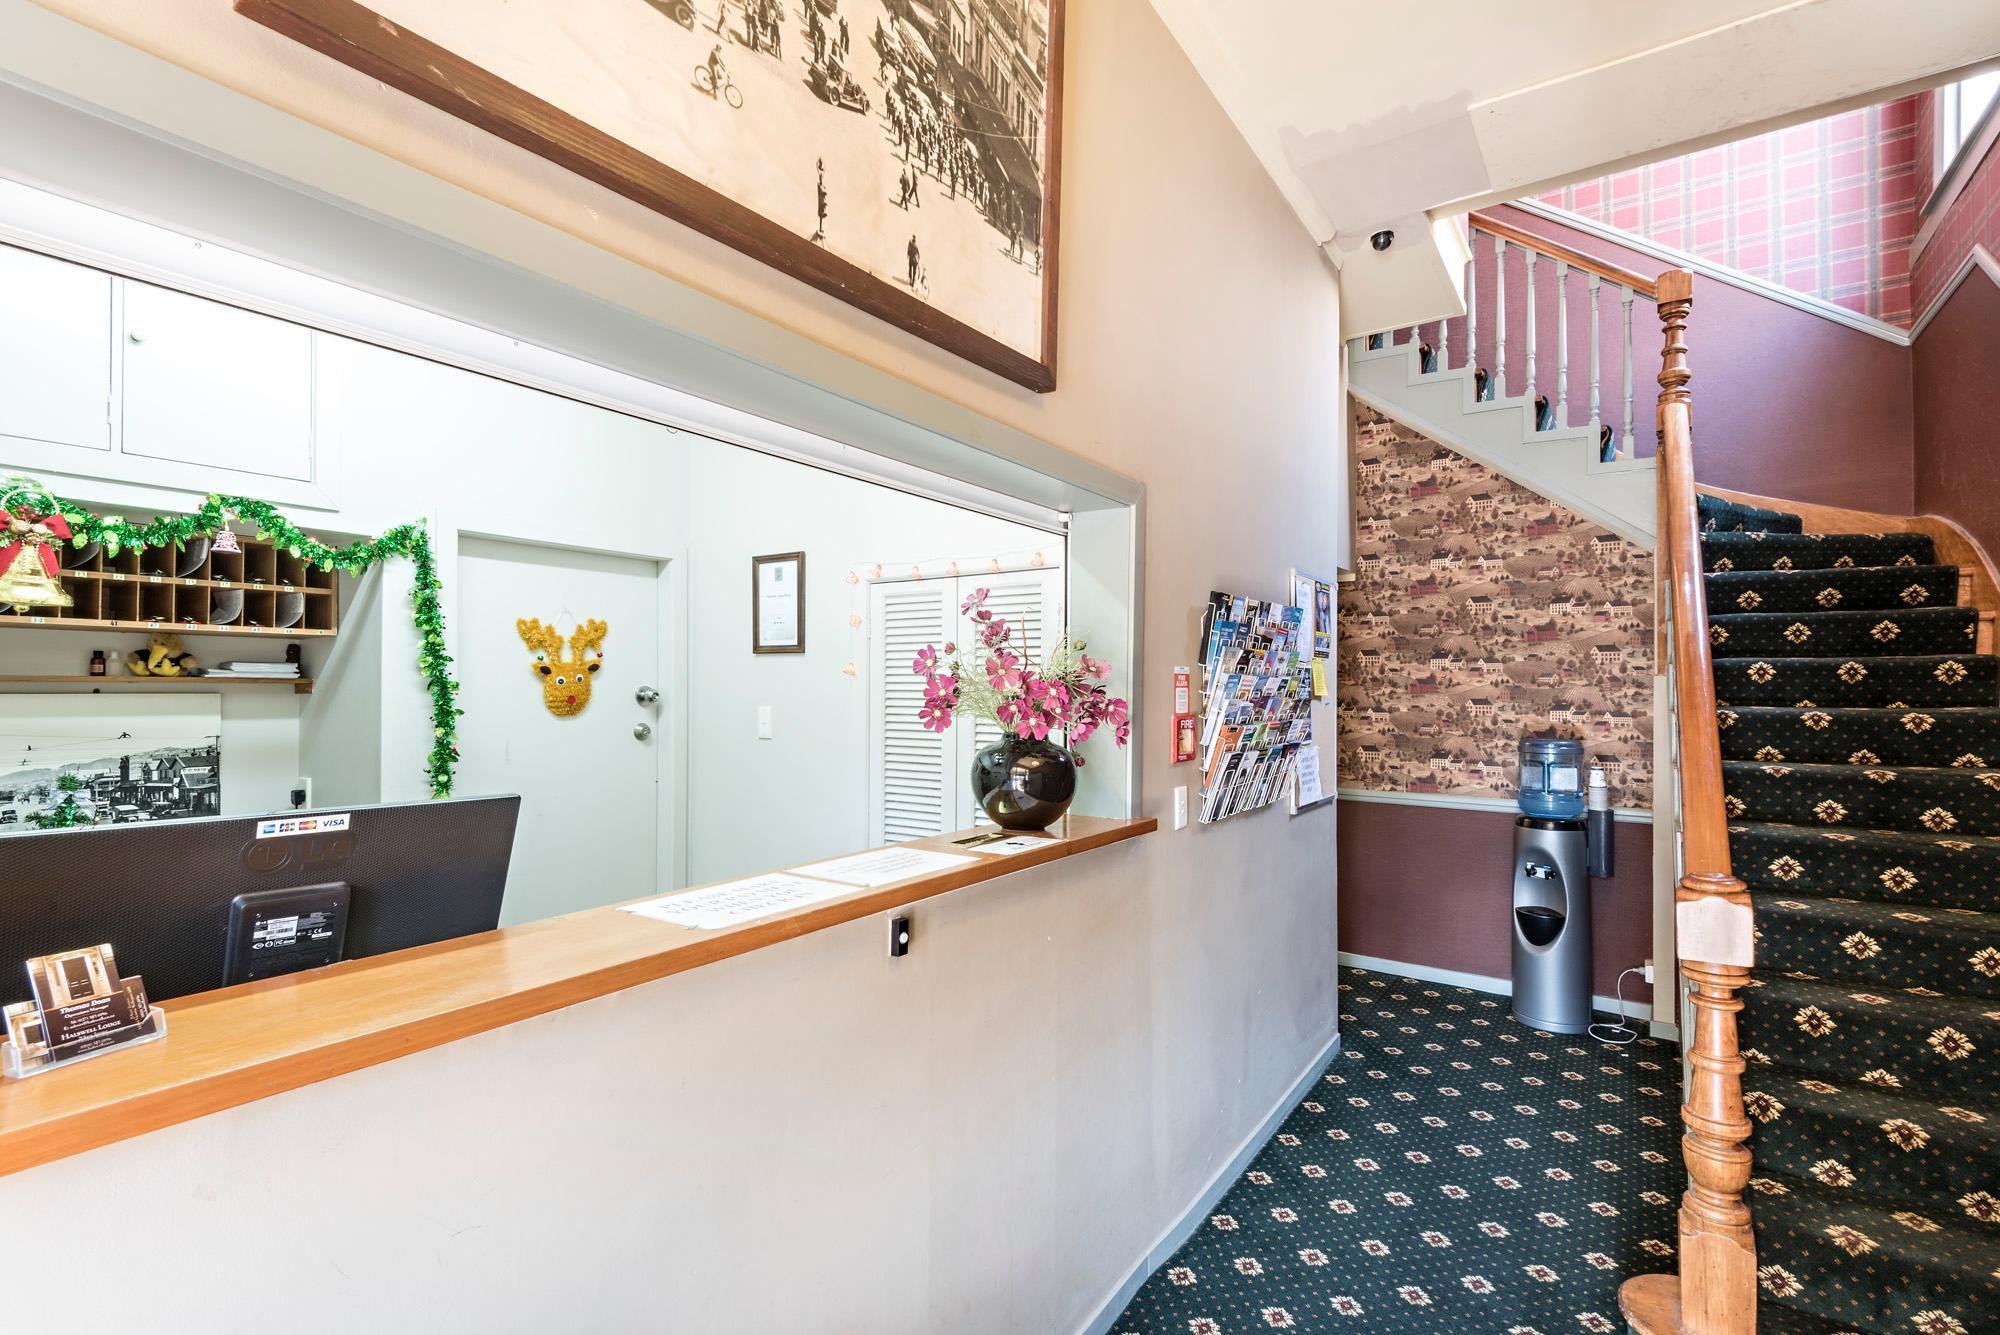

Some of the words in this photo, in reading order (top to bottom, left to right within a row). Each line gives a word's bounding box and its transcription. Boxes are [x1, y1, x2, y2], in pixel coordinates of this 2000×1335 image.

[1181, 720, 1194, 728] FIRE
[323, 819, 345, 827] VISA
[60, 1003, 90, 1014] Thomas
[98, 1021, 122, 1031] LODGE
